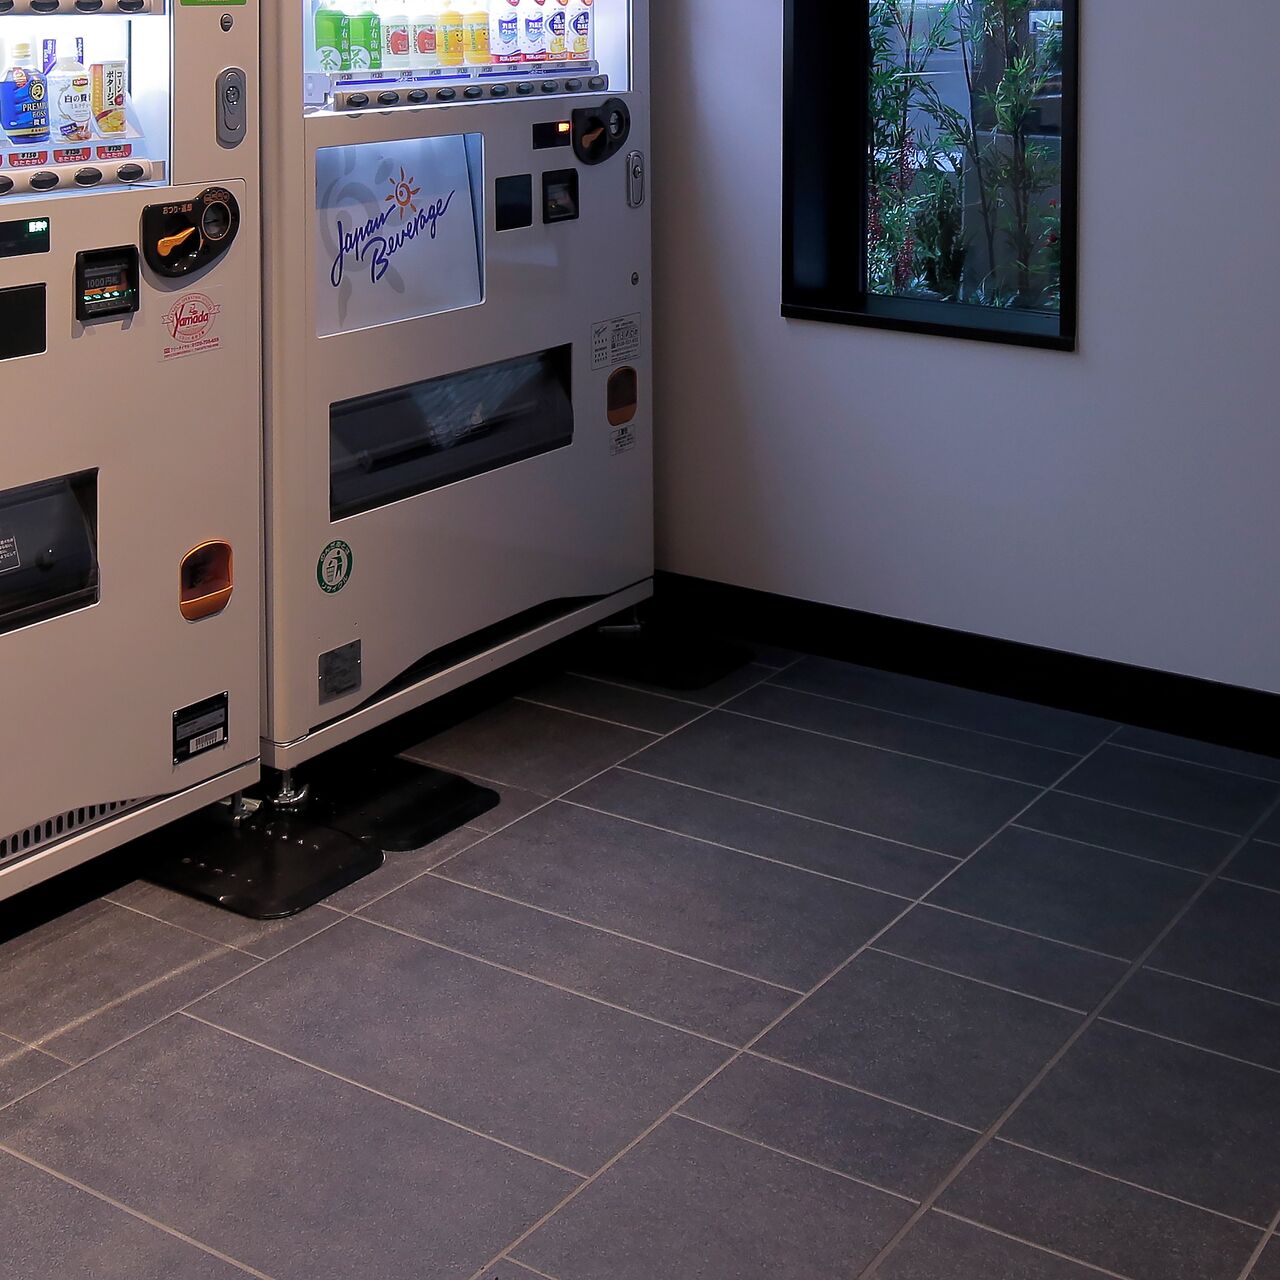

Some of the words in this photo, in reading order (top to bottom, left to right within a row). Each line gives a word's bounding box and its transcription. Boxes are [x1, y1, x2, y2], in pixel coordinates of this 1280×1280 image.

[320, 48, 339, 71] 茶
[106, 70, 115, 107] ポタージュ
[116, 71, 124, 94] コーン
[32, 111, 47, 119] BOSS
[331, 203, 396, 287] Japan
[360, 189, 455, 284] Beverage
[172, 303, 209, 338] Yamada
[321, 575, 348, 593] リサイクル
